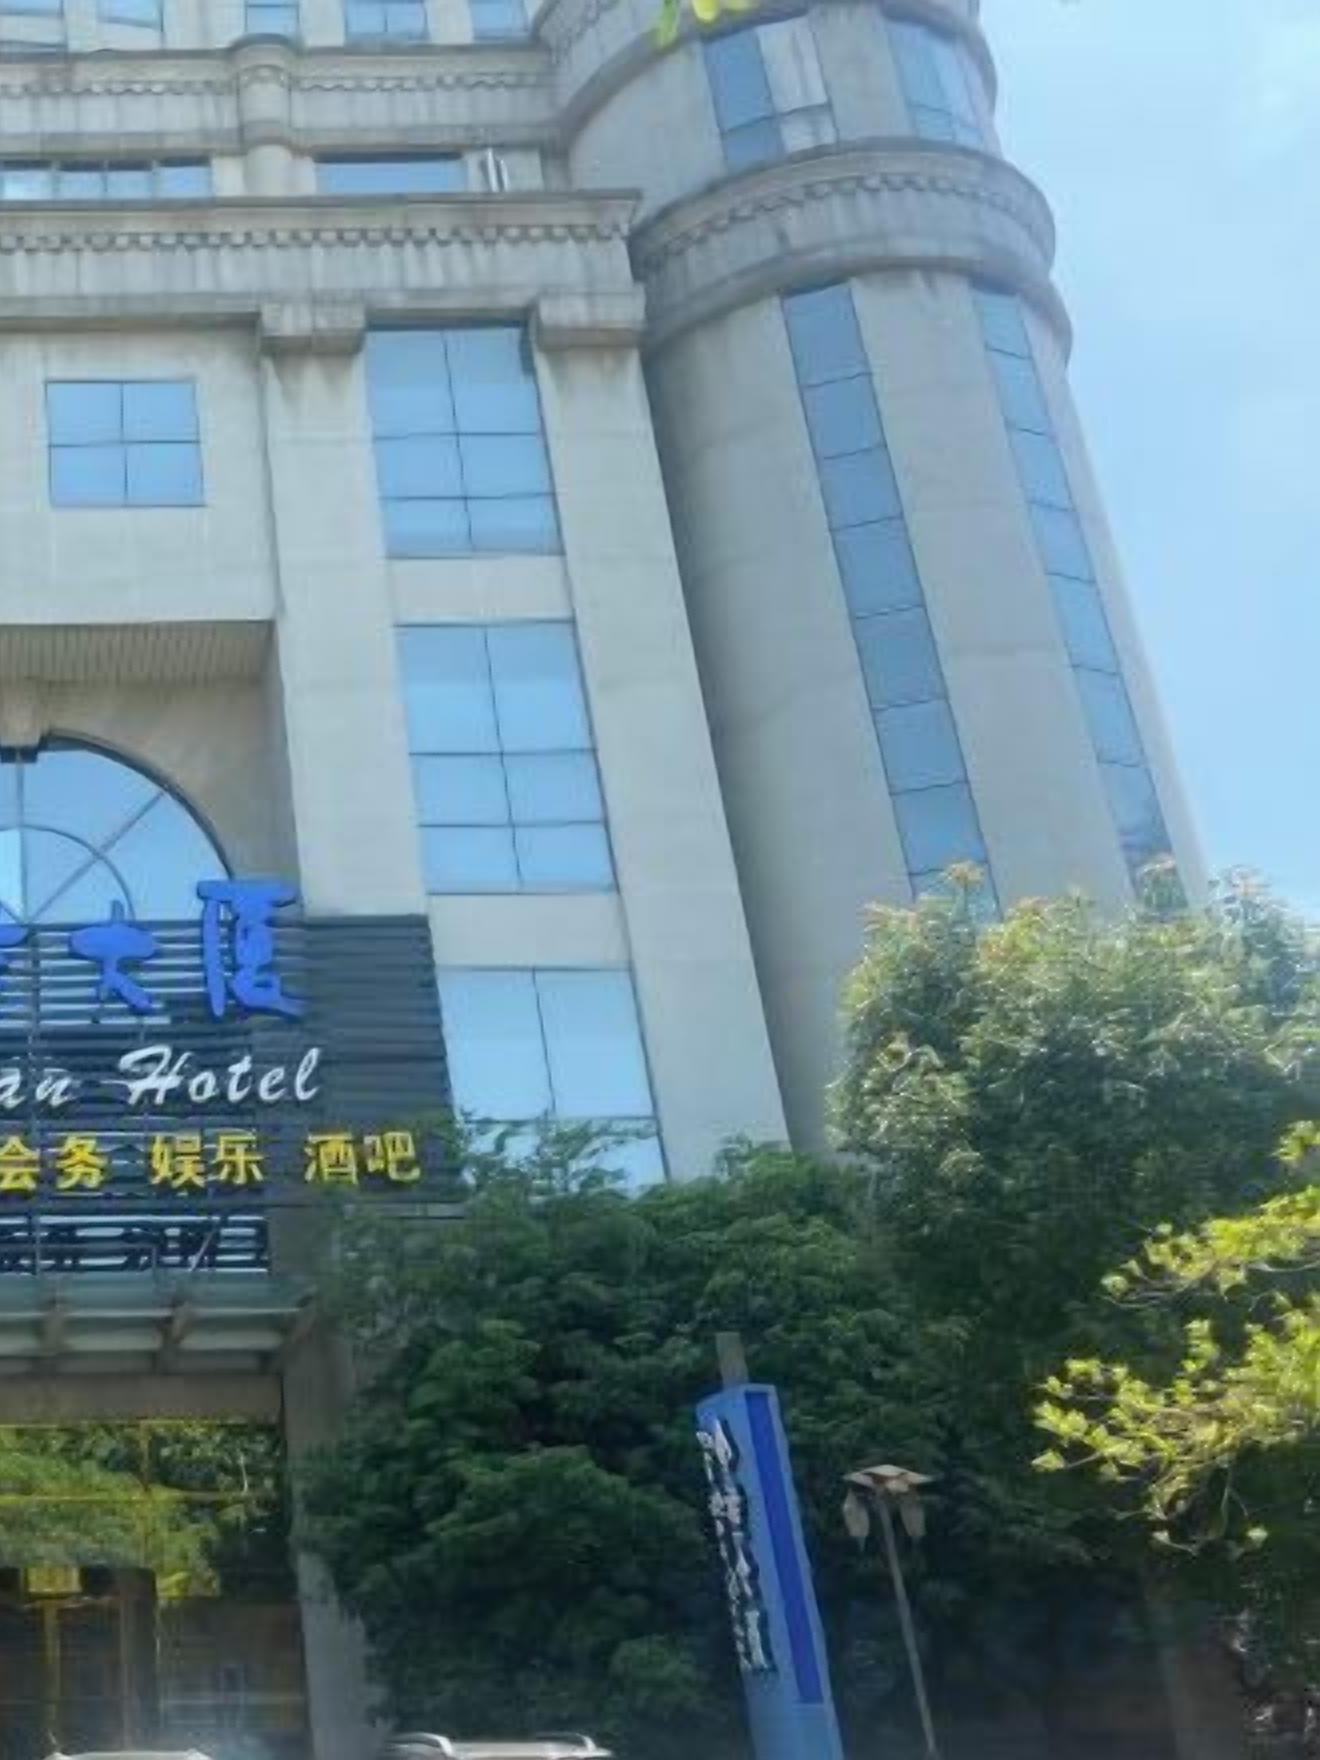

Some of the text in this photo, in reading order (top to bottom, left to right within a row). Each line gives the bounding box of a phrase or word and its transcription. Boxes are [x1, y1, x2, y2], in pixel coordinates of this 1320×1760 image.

[112, 1045, 320, 1106] Hotel
[151, 1131, 266, 1188] 娱乐
[304, 1131, 420, 1184] 酒吧
